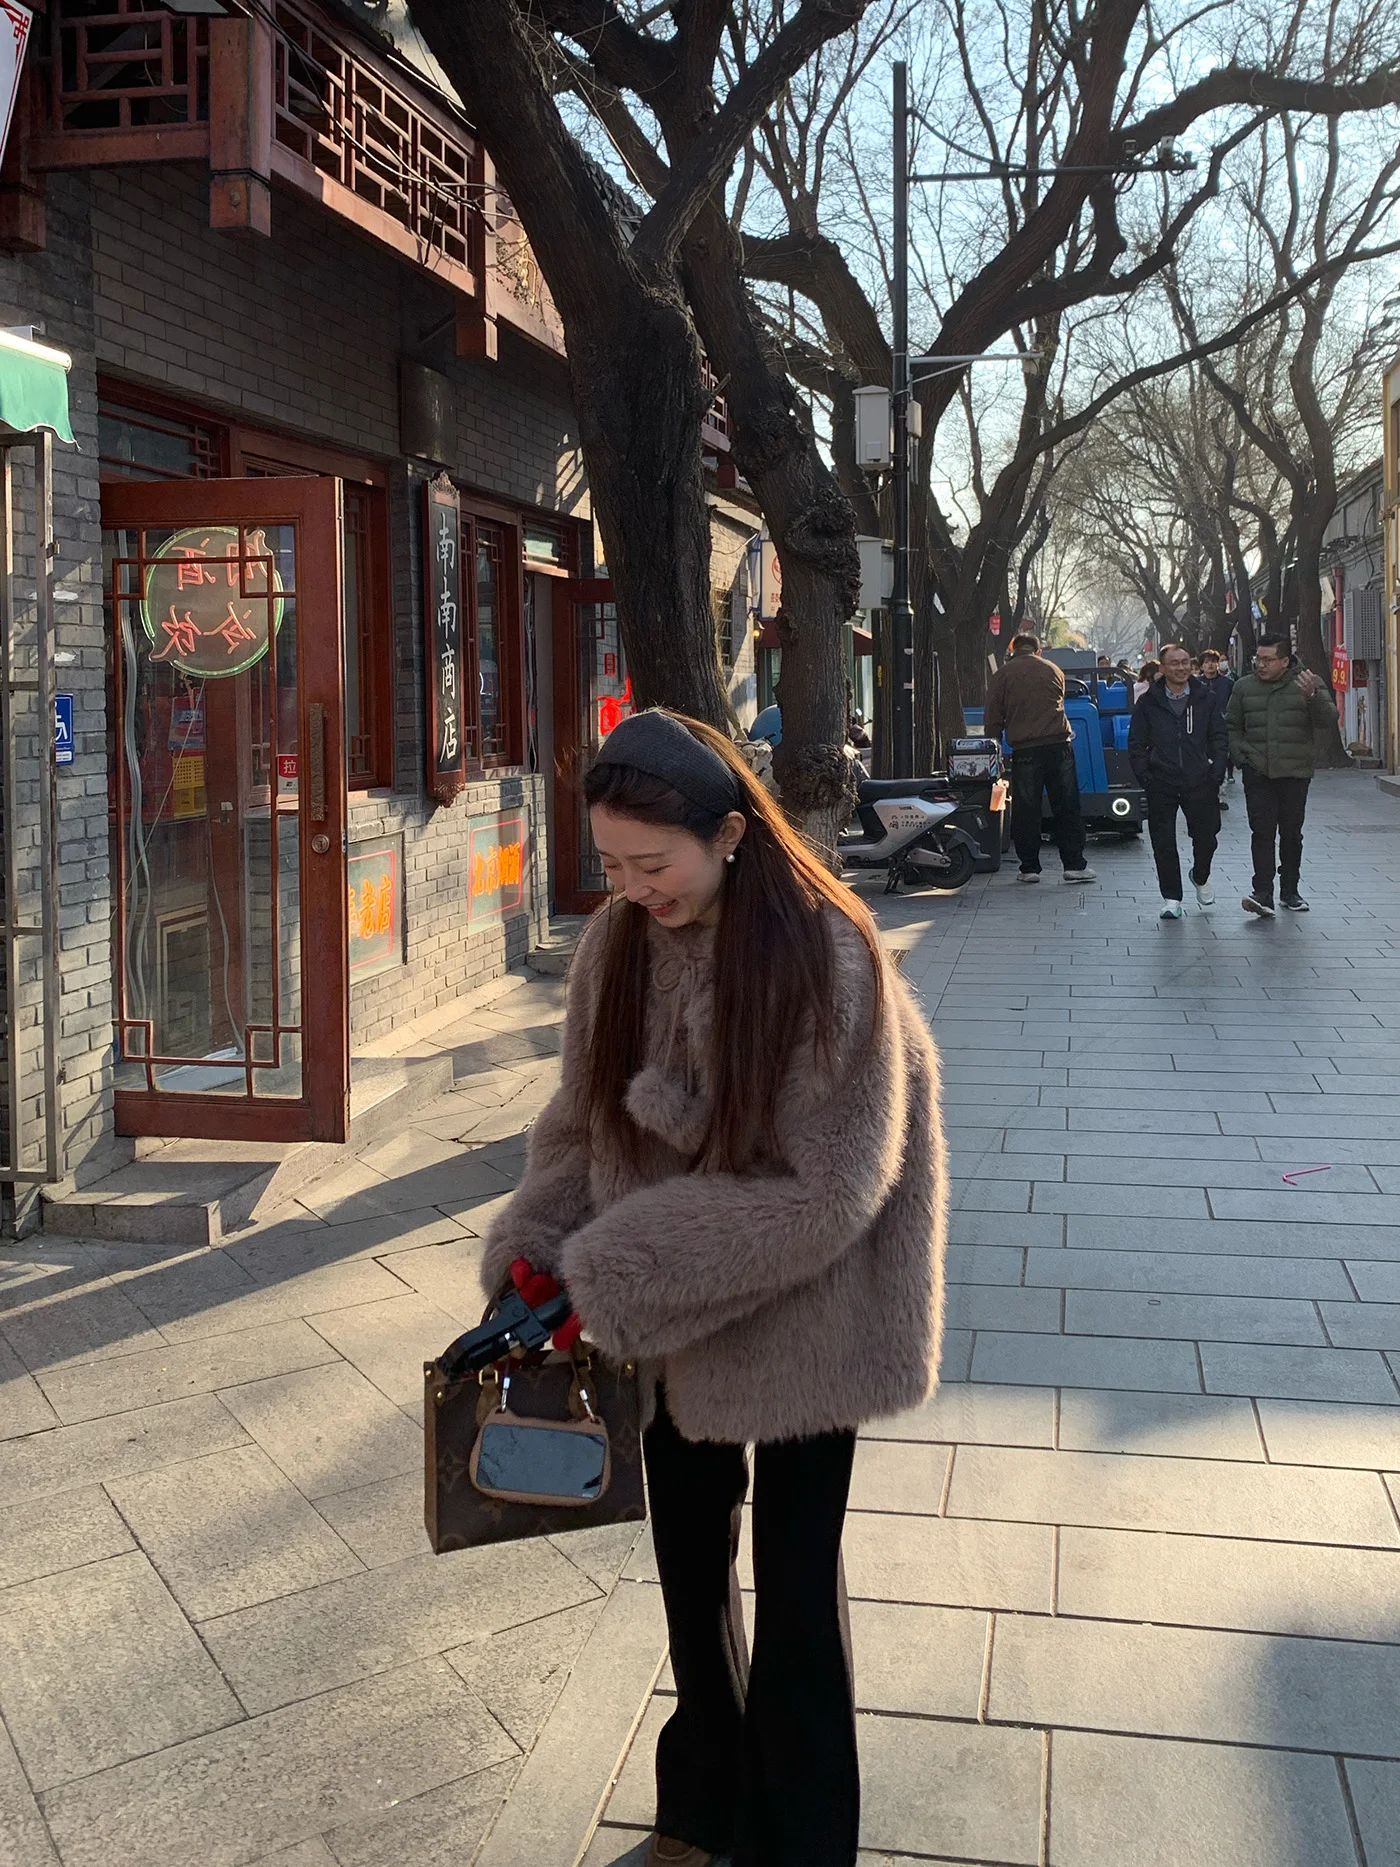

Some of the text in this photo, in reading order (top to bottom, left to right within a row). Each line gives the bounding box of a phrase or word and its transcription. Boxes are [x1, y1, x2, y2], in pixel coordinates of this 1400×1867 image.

[435, 512, 458, 764] 南南商店
[283, 759, 298, 775] 拉
